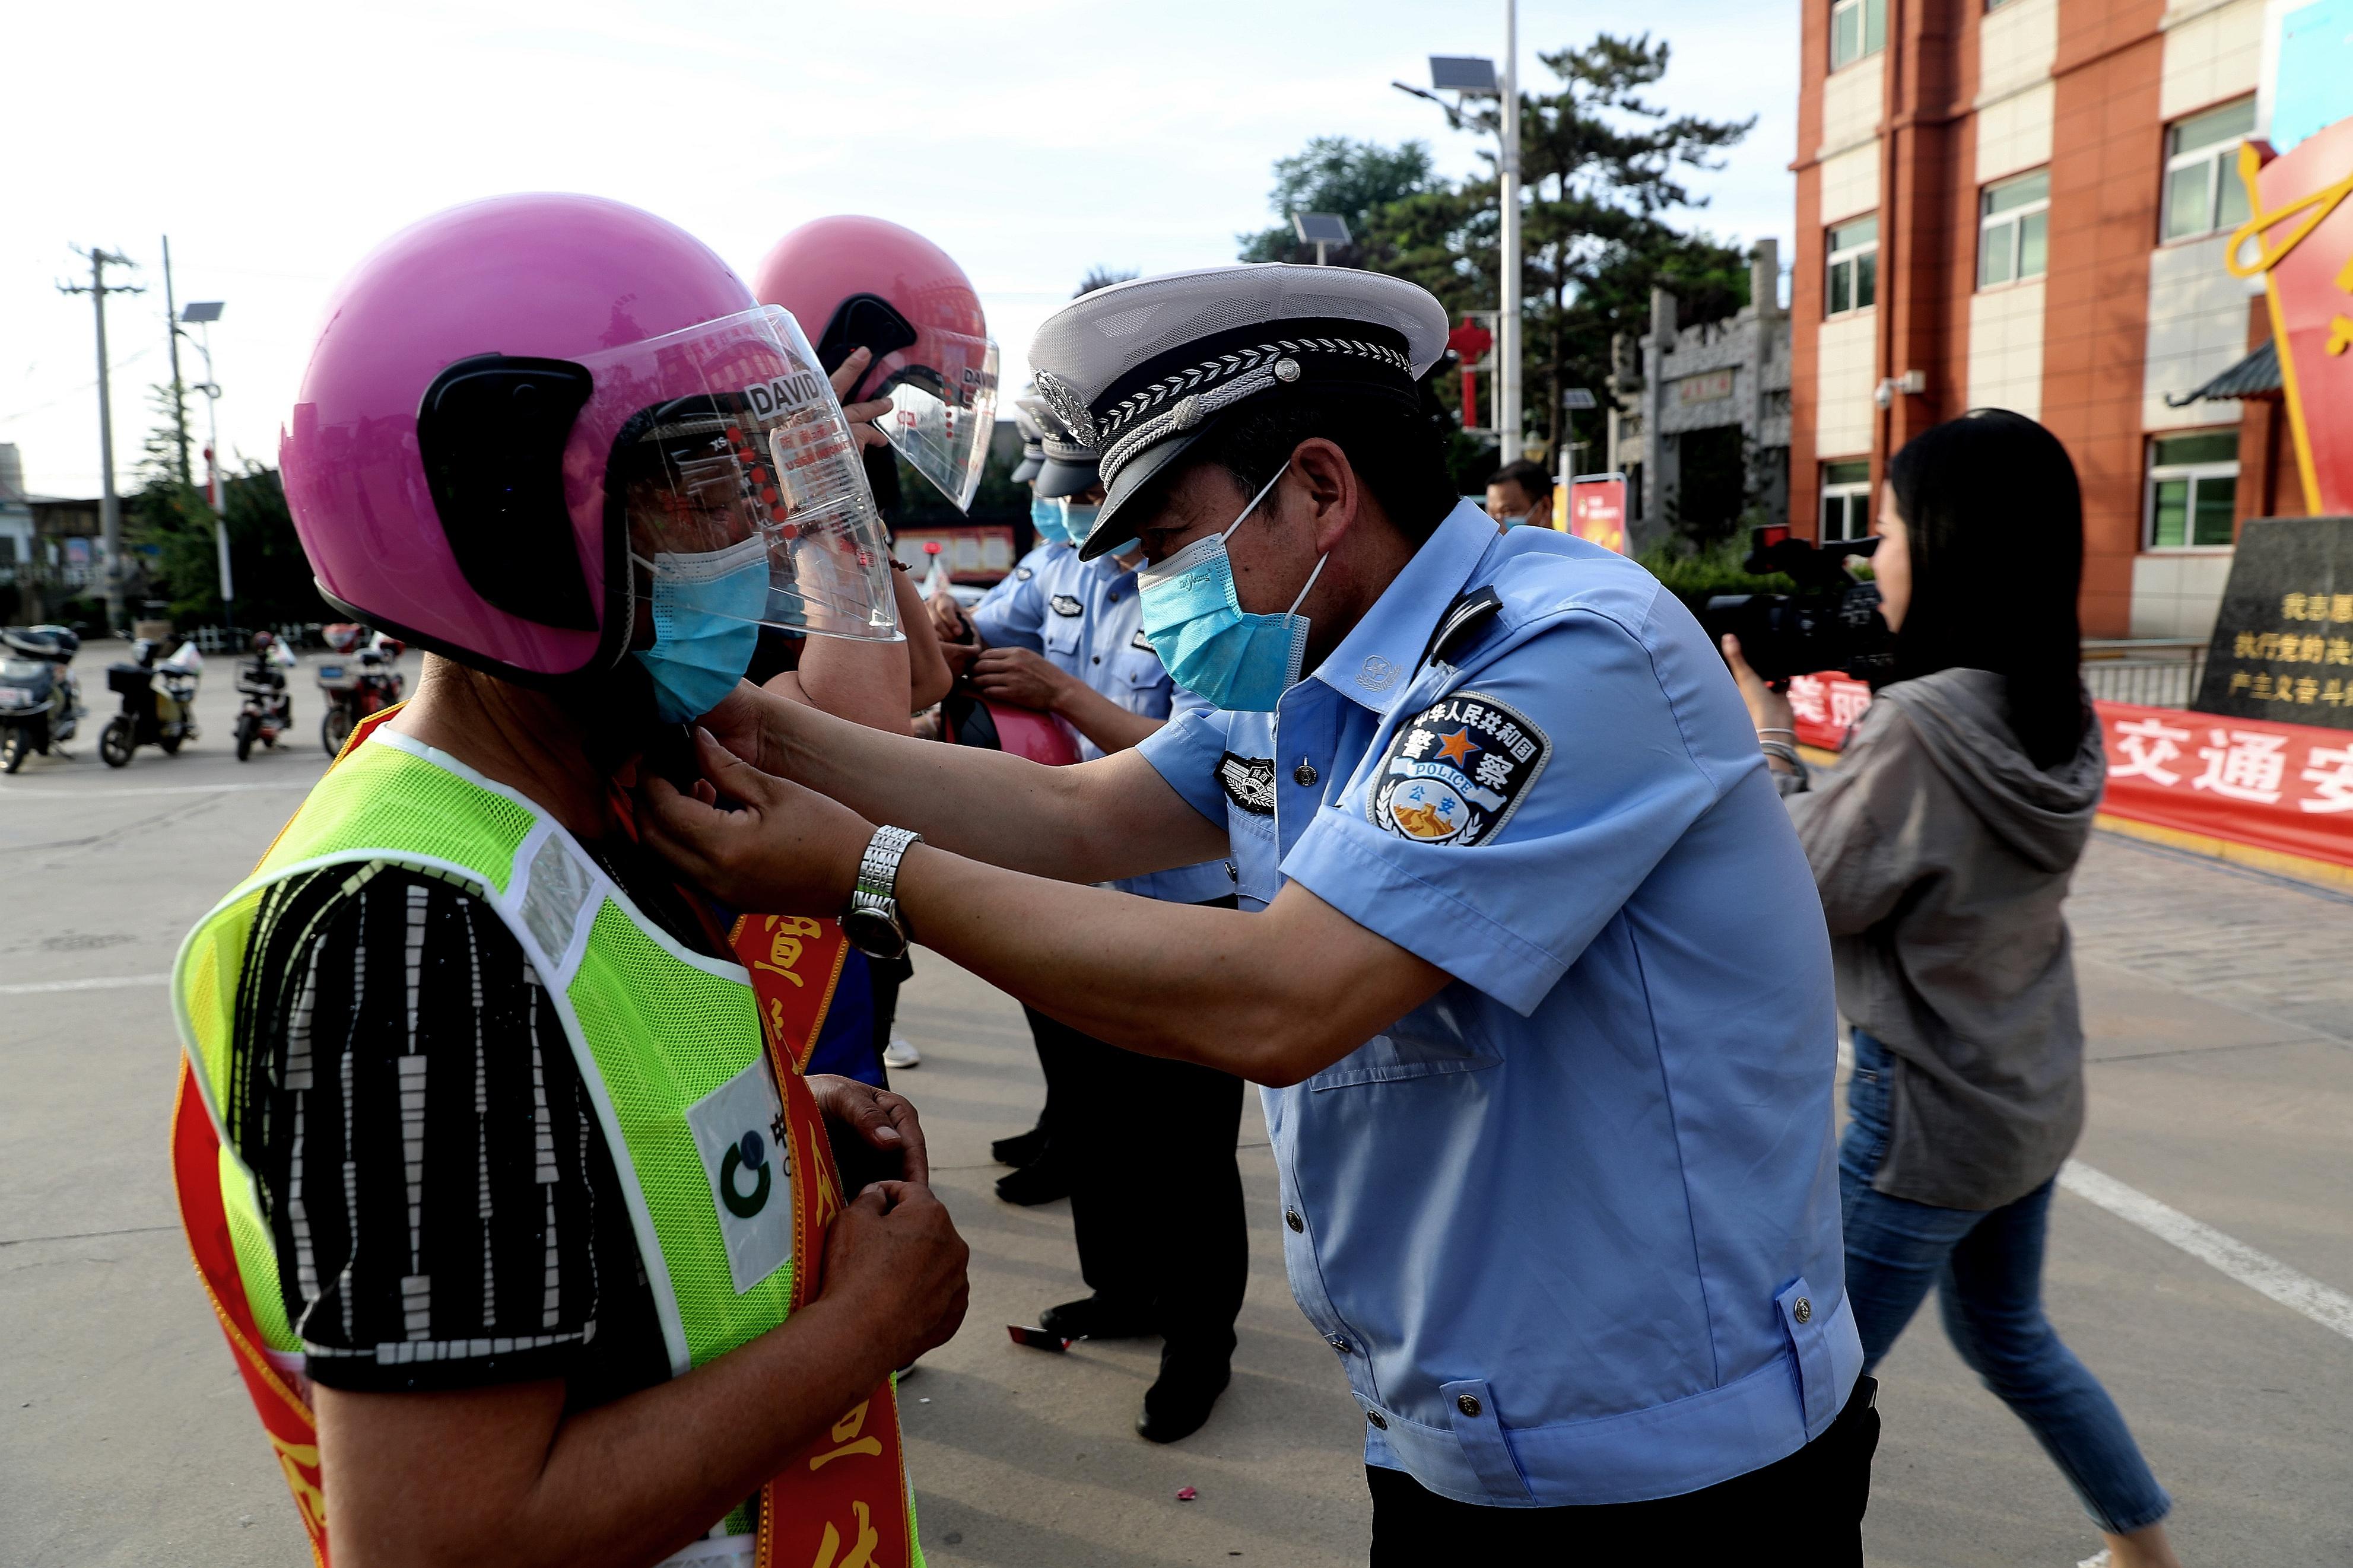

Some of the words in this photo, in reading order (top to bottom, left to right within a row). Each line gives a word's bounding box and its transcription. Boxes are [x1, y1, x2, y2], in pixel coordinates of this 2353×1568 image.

[750, 373, 821, 415] DAVID
[1413, 701, 1538, 764] 中华人民共和国
[1251, 769, 1270, 783] 陕西
[1414, 764, 1474, 793] POLICE
[2109, 718, 2353, 813] 交通安
[1244, 778, 1263, 791] POLICE
